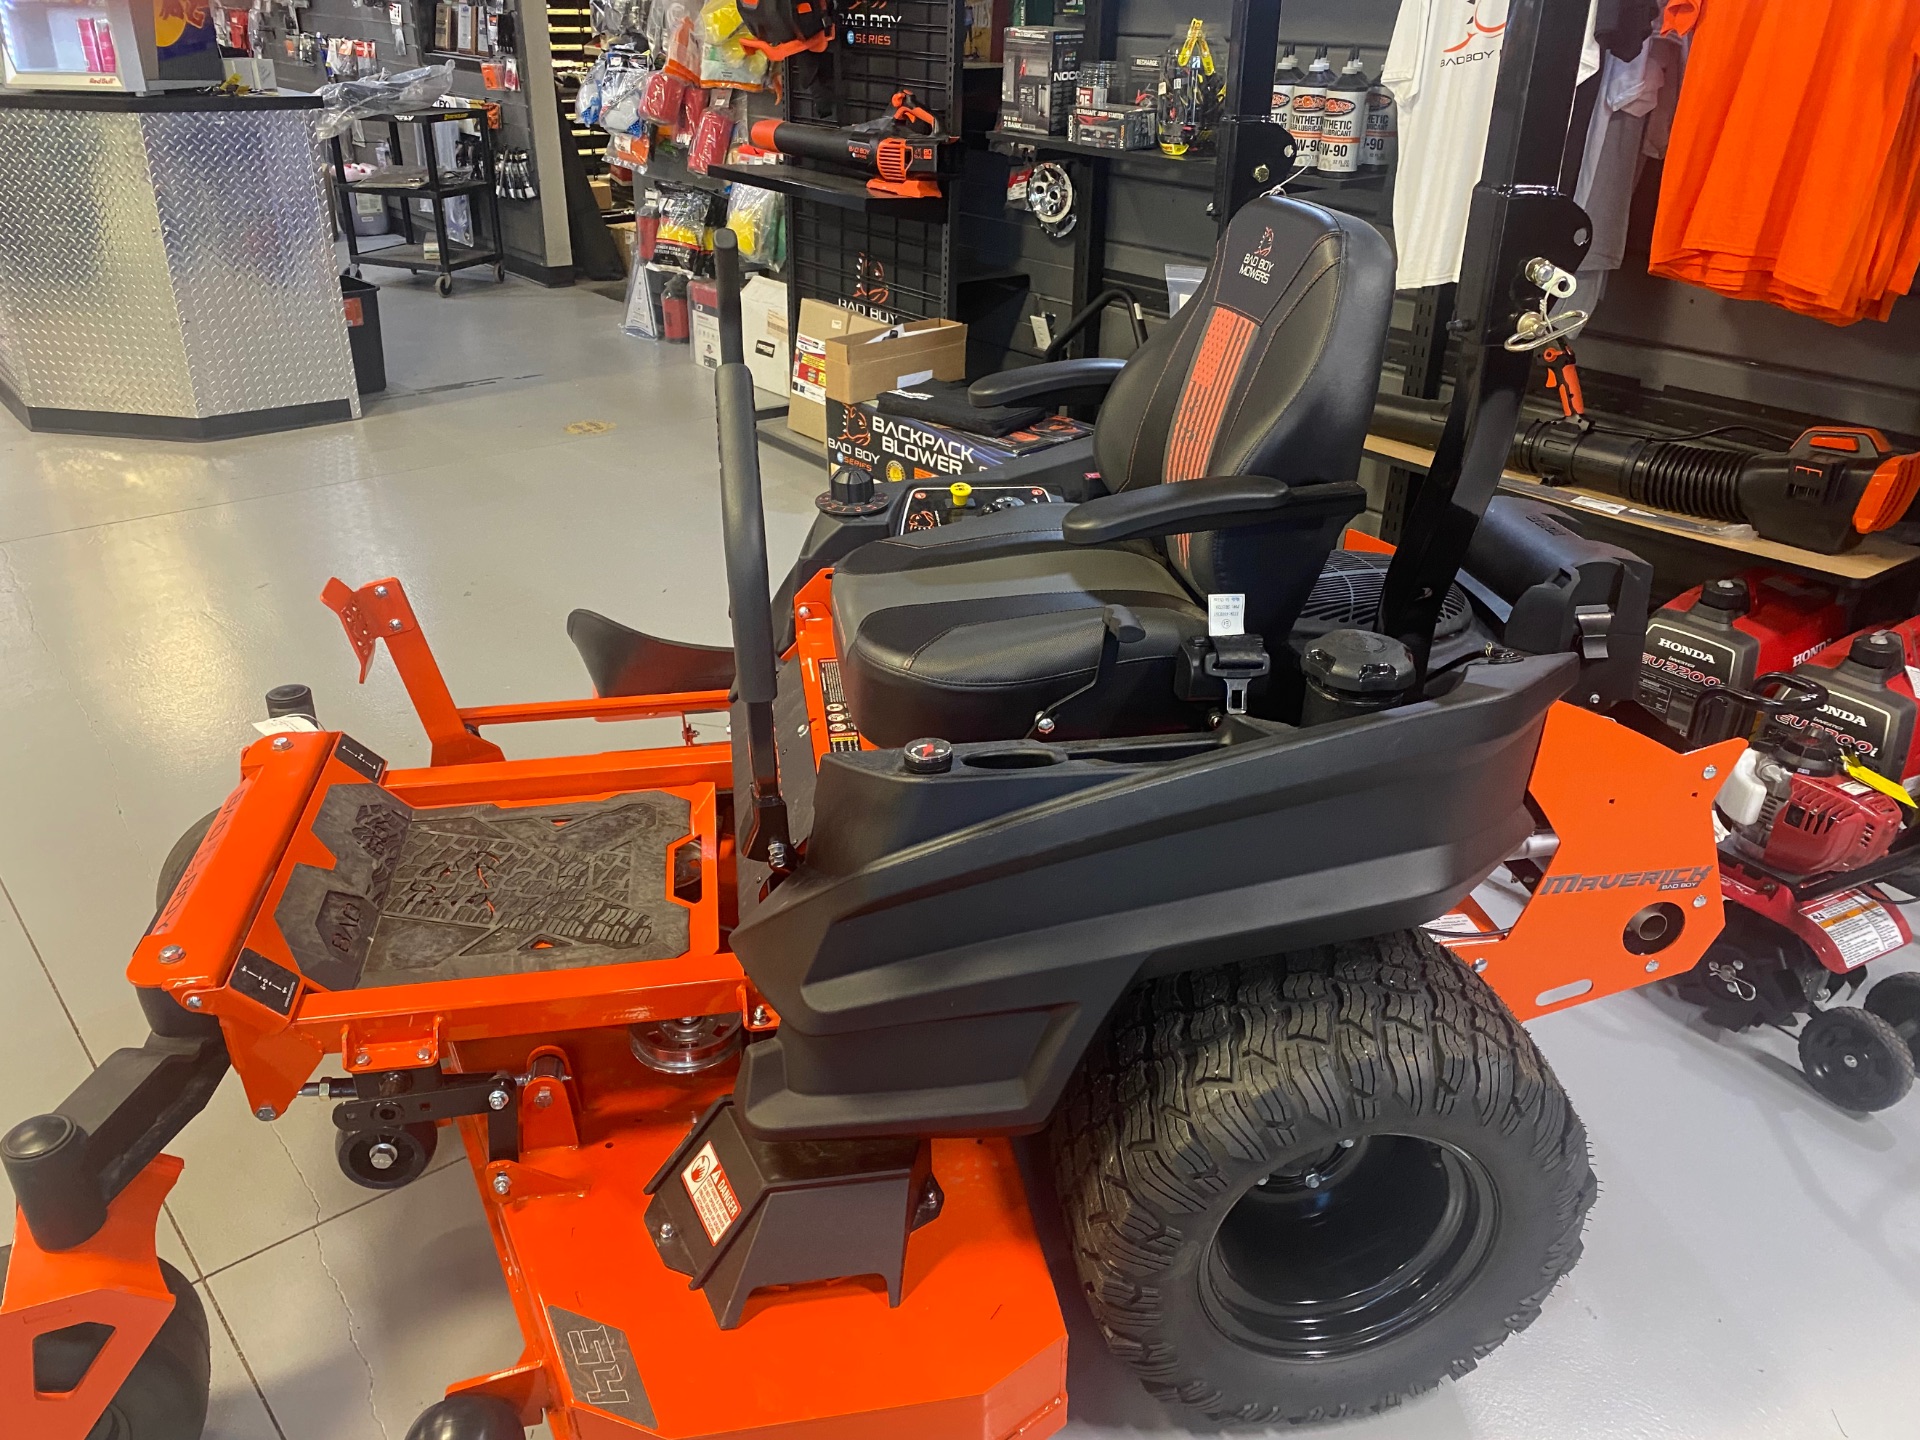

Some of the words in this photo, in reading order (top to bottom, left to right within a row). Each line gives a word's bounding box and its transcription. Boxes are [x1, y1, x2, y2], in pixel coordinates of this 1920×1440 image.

[1238, 263, 1271, 285] MOWERS
[1243, 253, 1259, 267] BAD
[1258, 258, 1275, 273] BOY
[838, 298, 866, 317] BAD
[870, 307, 898, 326] BOY
[828, 437, 852, 455] BAD
[854, 447, 880, 465] BOY
[872, 415, 974, 464] BACKPACK
[843, 455, 873, 472] SERIES
[881, 435, 963, 476] BLOWER
[1657, 637, 1716, 665] HONDA
[1816, 703, 1868, 728] ONDA
[1539, 864, 1714, 896] MAVERICK
[1661, 883, 1679, 891] BAD
[1680, 881, 1698, 889] BOY
[717, 1179, 739, 1217] DANGER
[567, 1324, 630, 1405] 54
